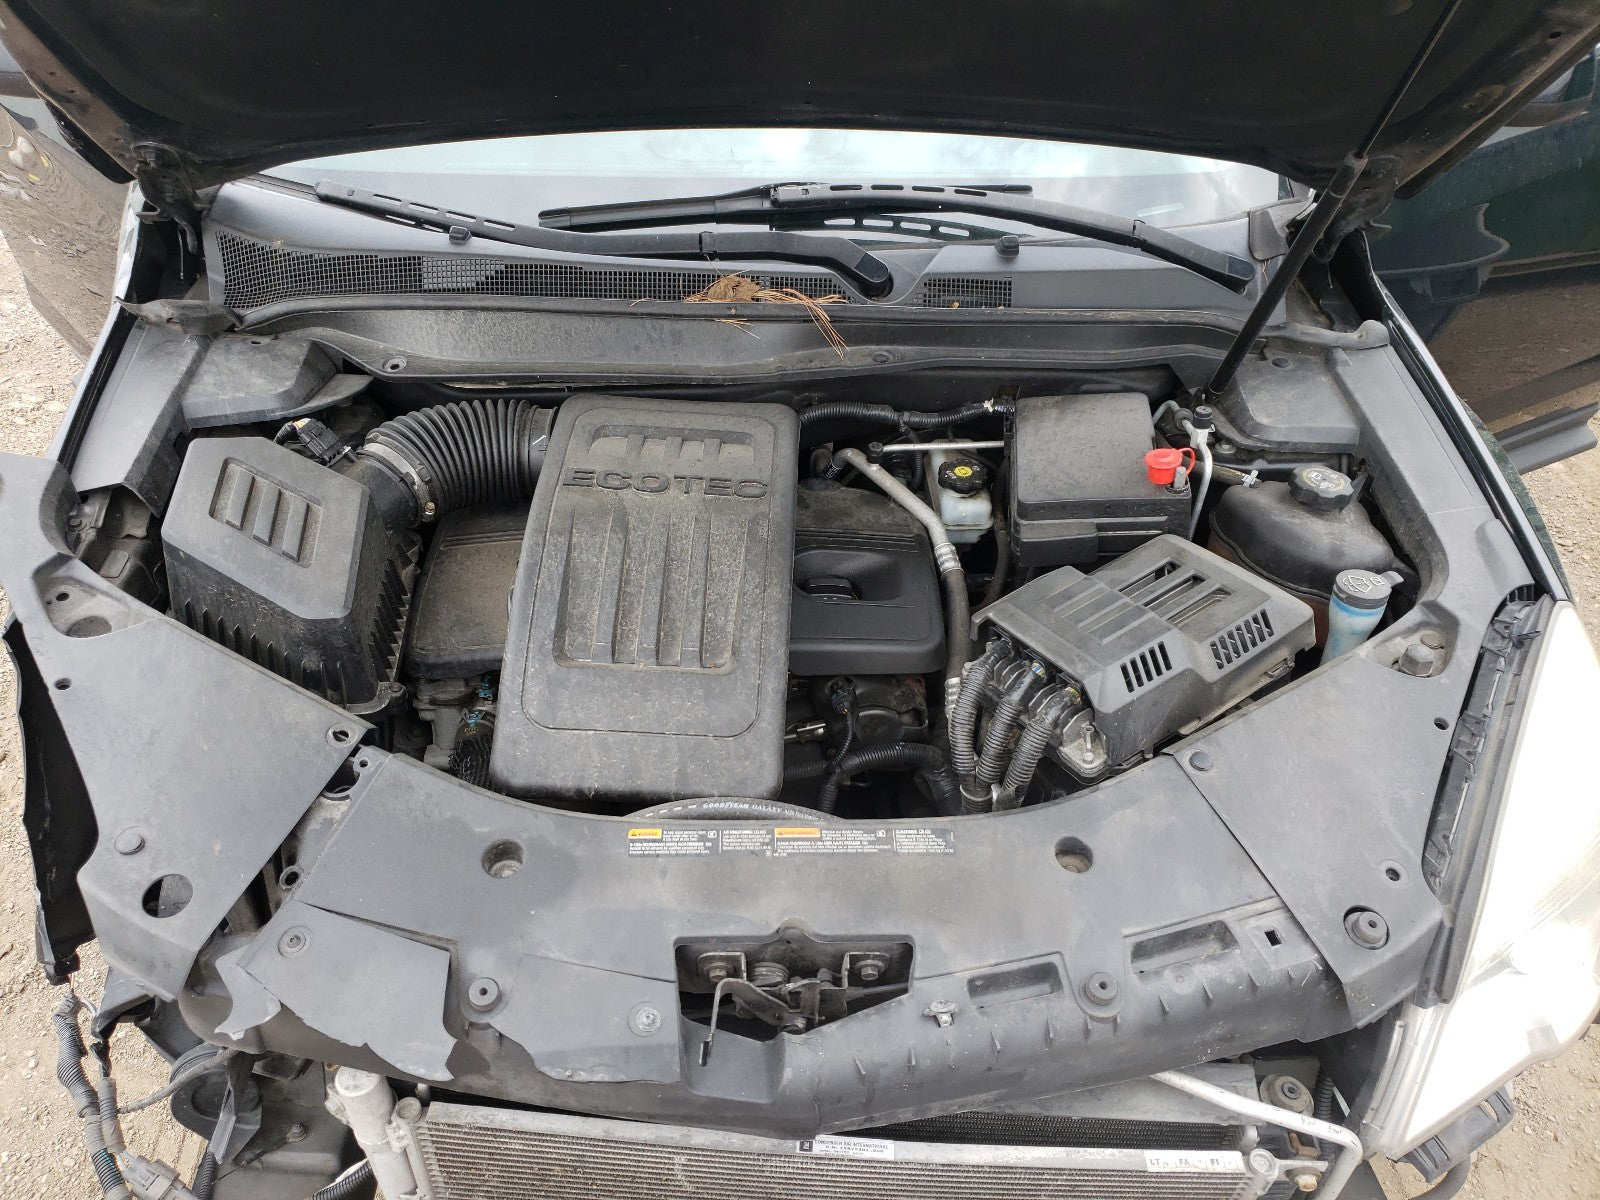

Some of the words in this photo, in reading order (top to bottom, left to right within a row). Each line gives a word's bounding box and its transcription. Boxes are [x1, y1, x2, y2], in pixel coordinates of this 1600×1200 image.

[563, 468, 768, 499] ECOTEC
[702, 801, 750, 810] GOODYEAR
[752, 804, 783, 813] GALAXY
